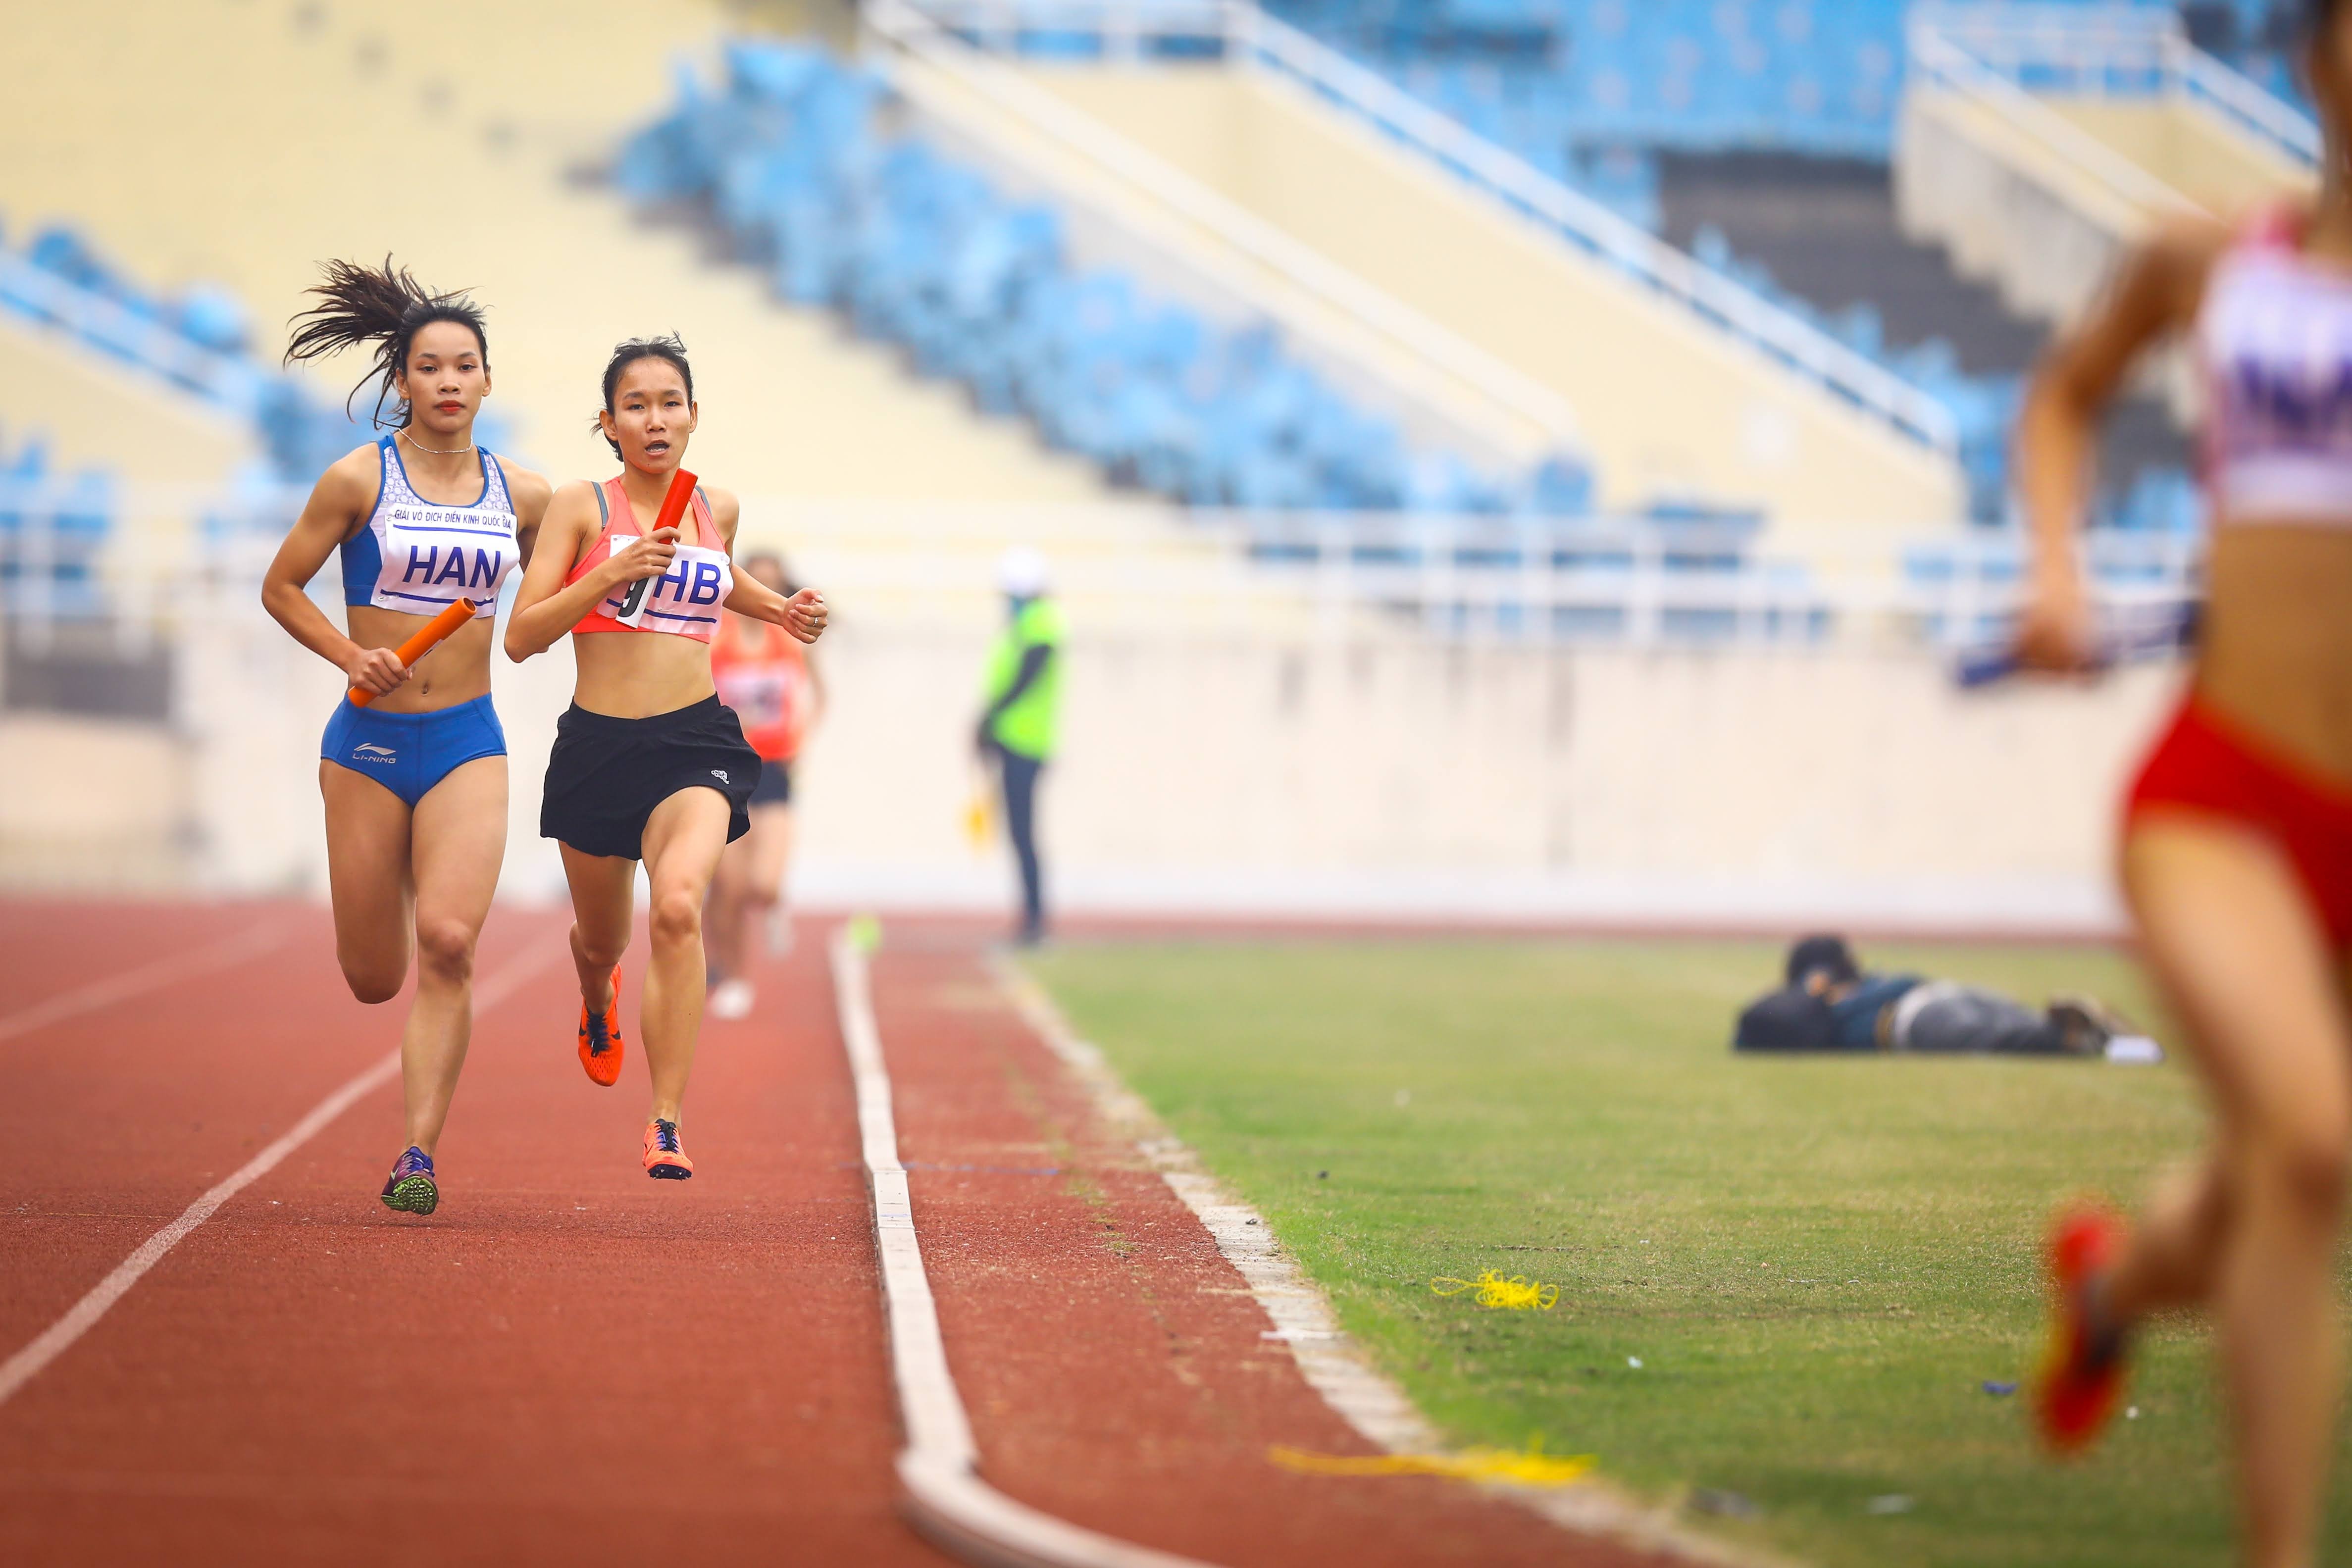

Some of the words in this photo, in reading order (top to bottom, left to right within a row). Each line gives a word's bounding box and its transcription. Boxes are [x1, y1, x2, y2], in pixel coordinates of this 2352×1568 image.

[463, 514, 480, 525] KINH
[402, 546, 501, 588] HAN
[353, 753, 396, 764] LI-NING
